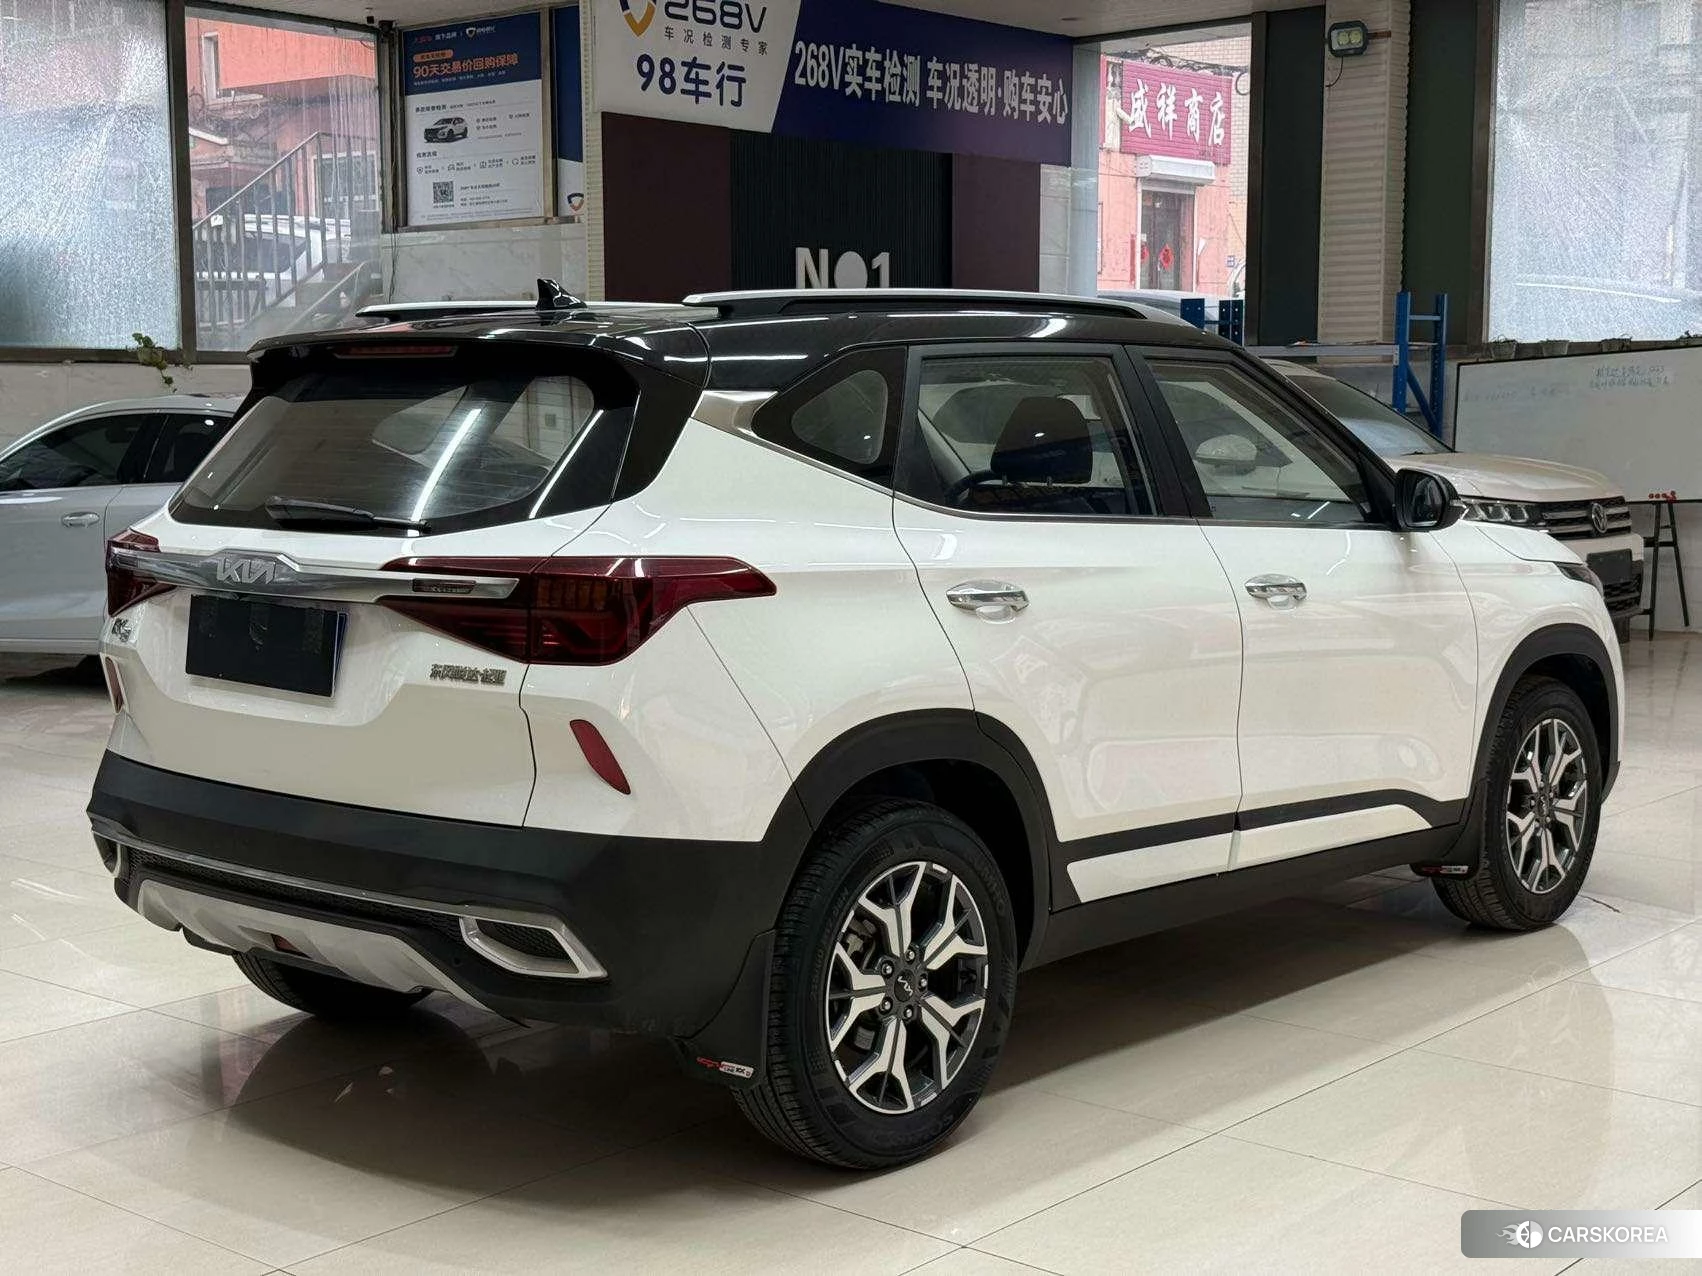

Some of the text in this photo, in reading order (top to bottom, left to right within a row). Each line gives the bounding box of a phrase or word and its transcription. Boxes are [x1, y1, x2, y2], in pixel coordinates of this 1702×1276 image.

[664, 0, 768, 33] 268V
[664, 25, 768, 56] 车况检测专家
[412, 53, 519, 79] 90天交易价回购保障
[636, 53, 747, 107] 98车行
[794, 40, 1068, 125] 268V实车检测 车况透明·购车安心
[1128, 79, 1226, 146] 盛祥商店
[216, 559, 276, 584] KIA
